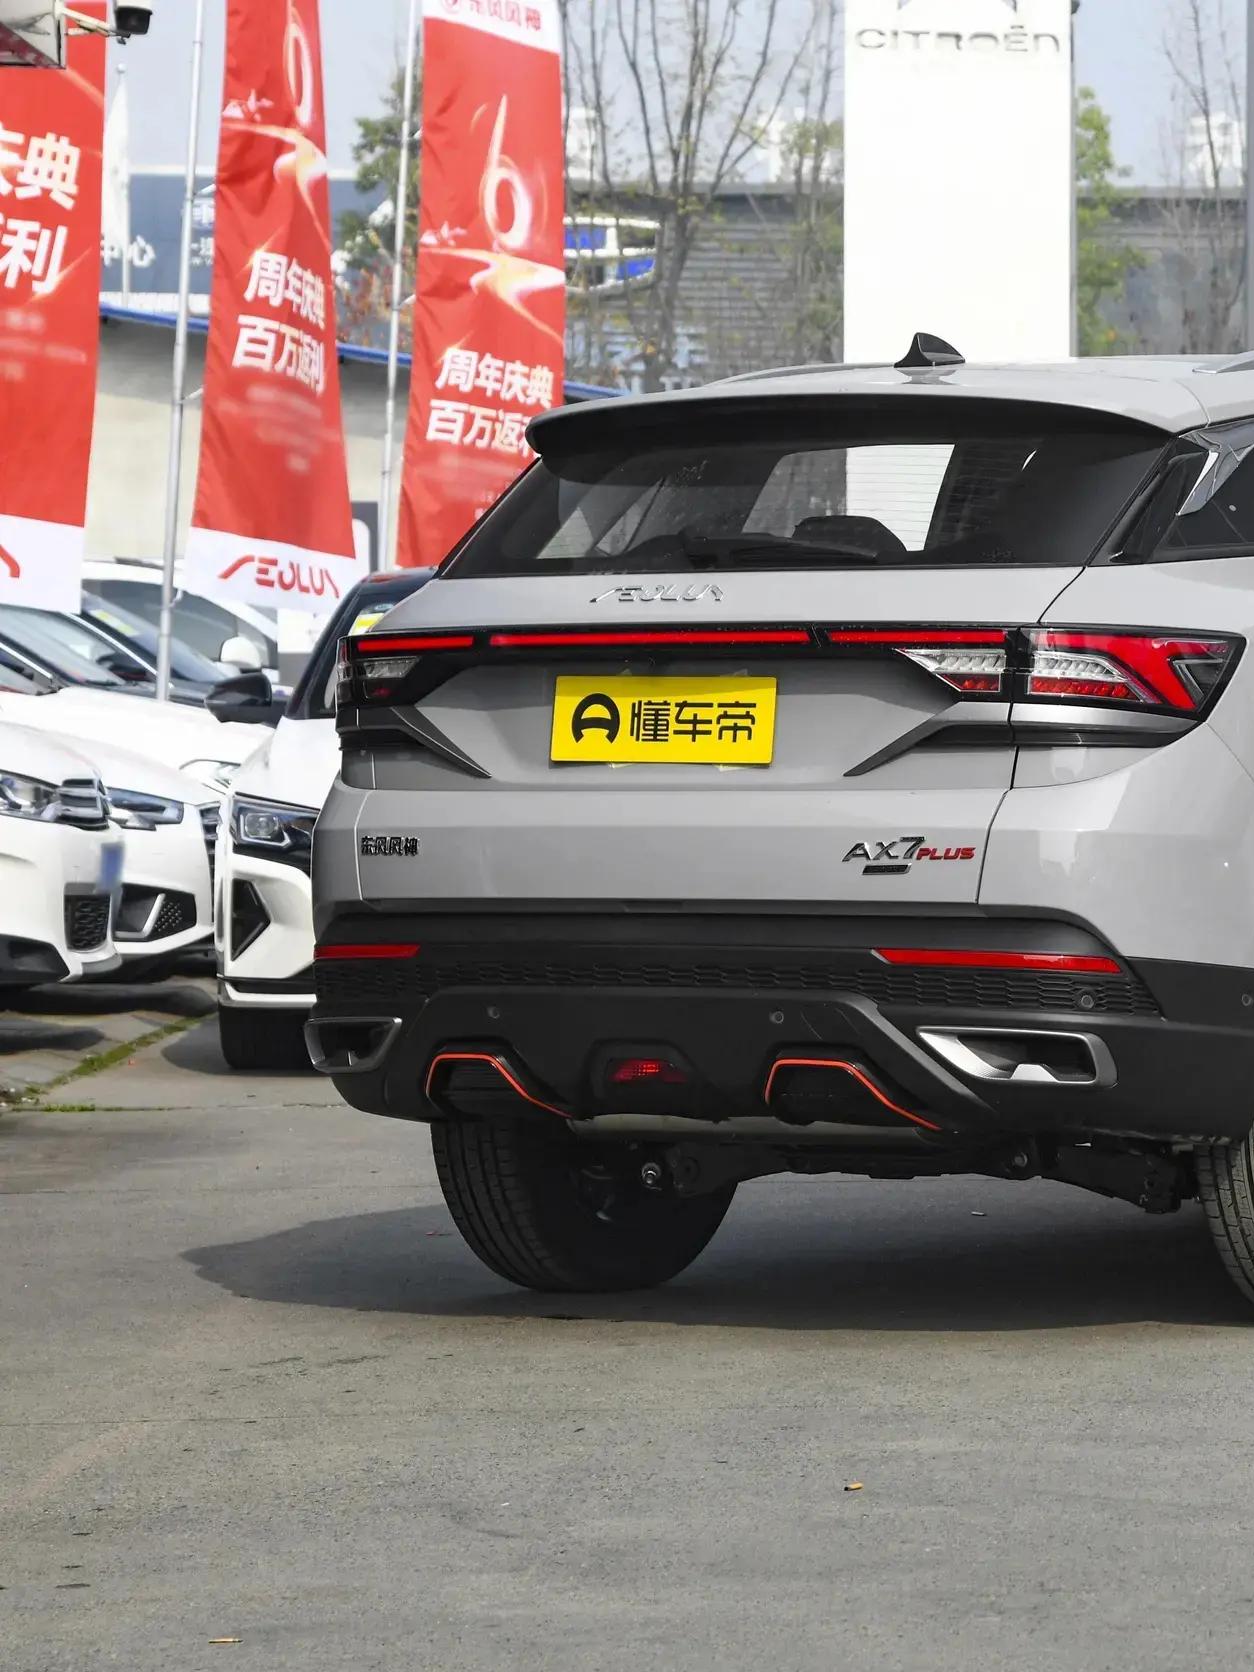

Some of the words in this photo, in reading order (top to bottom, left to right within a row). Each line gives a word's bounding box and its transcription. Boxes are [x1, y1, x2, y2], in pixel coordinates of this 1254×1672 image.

[0, 212, 69, 295] 利
[435, 347, 554, 410] 周年庆典
[218, 554, 340, 600] AEOLUS
[630, 700, 757, 743] 懂车帝
[361, 835, 419, 856] 东风风神
[841, 836, 925, 862] AX7
[916, 847, 976, 860] PLUS
